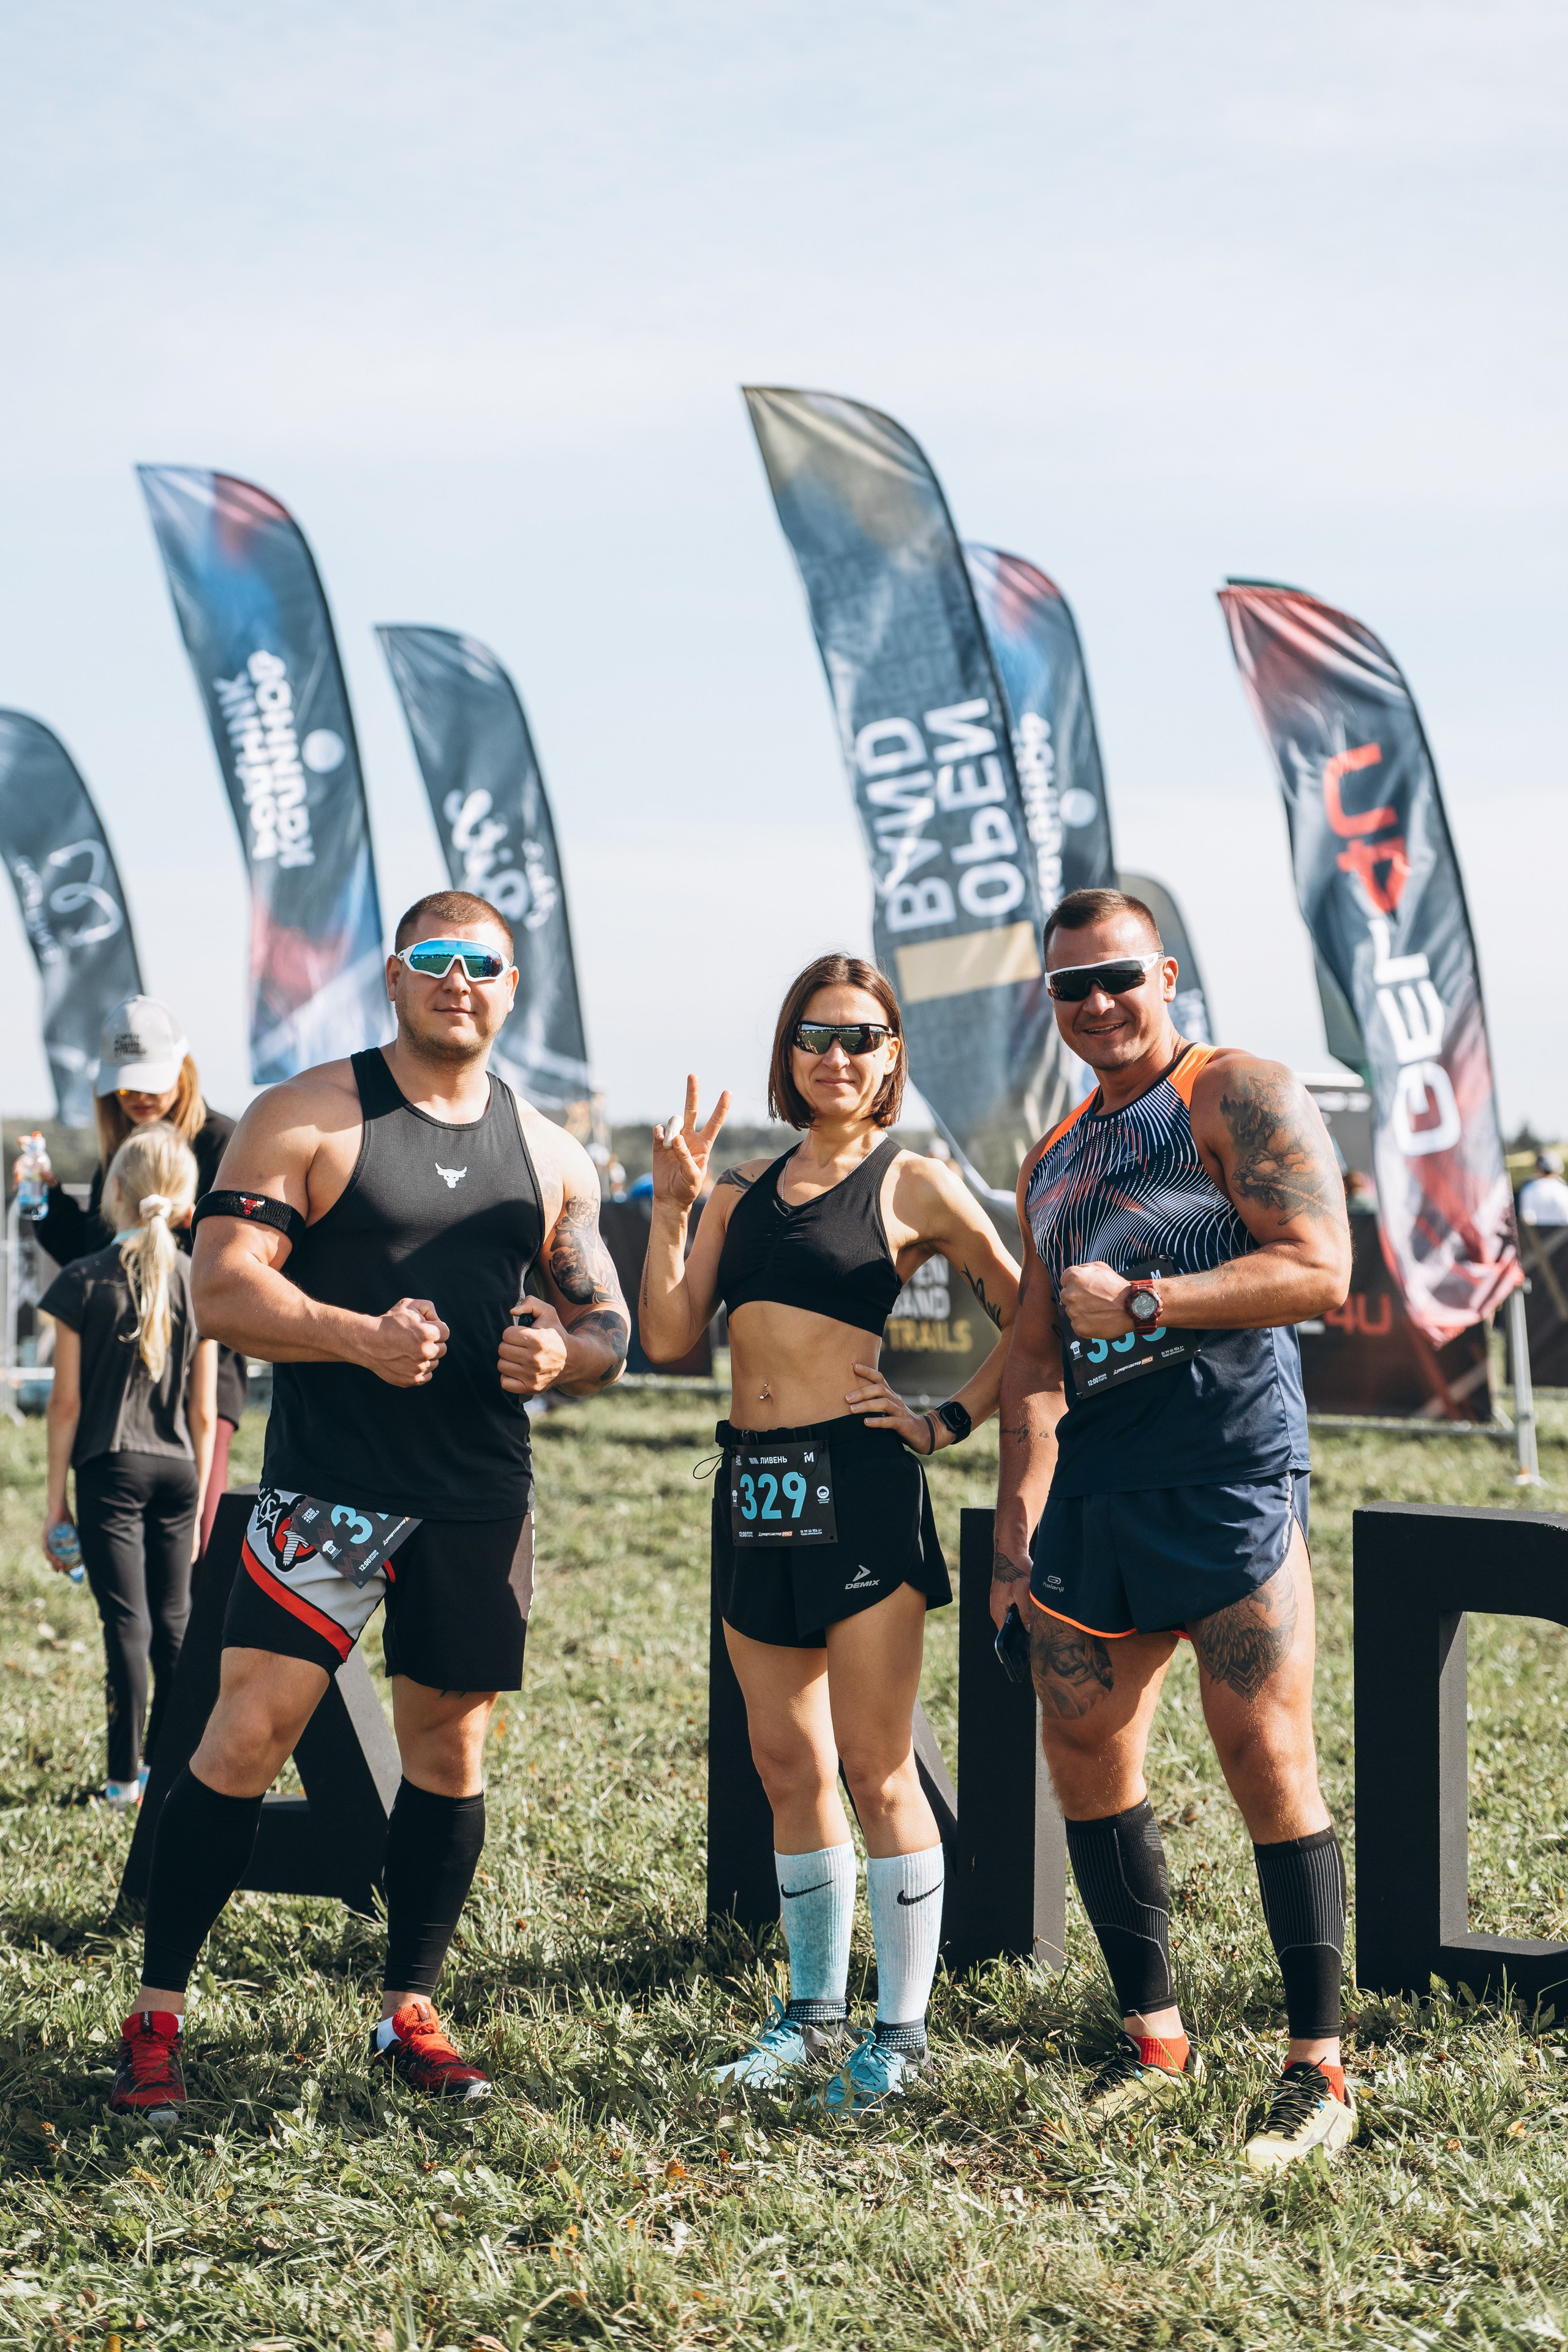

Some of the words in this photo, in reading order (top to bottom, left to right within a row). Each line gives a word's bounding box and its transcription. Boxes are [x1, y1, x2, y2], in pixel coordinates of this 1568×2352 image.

[888, 1318, 973, 1353] TRAILS
[1087, 1377, 1099, 1387] 12:00
[760, 1455, 788, 1464] ЛИВЕНЬ
[740, 1472, 807, 1520] 329
[358, 1558, 372, 1572] 12:00
[845, 1578, 880, 1590] DEMIX
[1042, 1581, 1065, 1593] Kalenji
